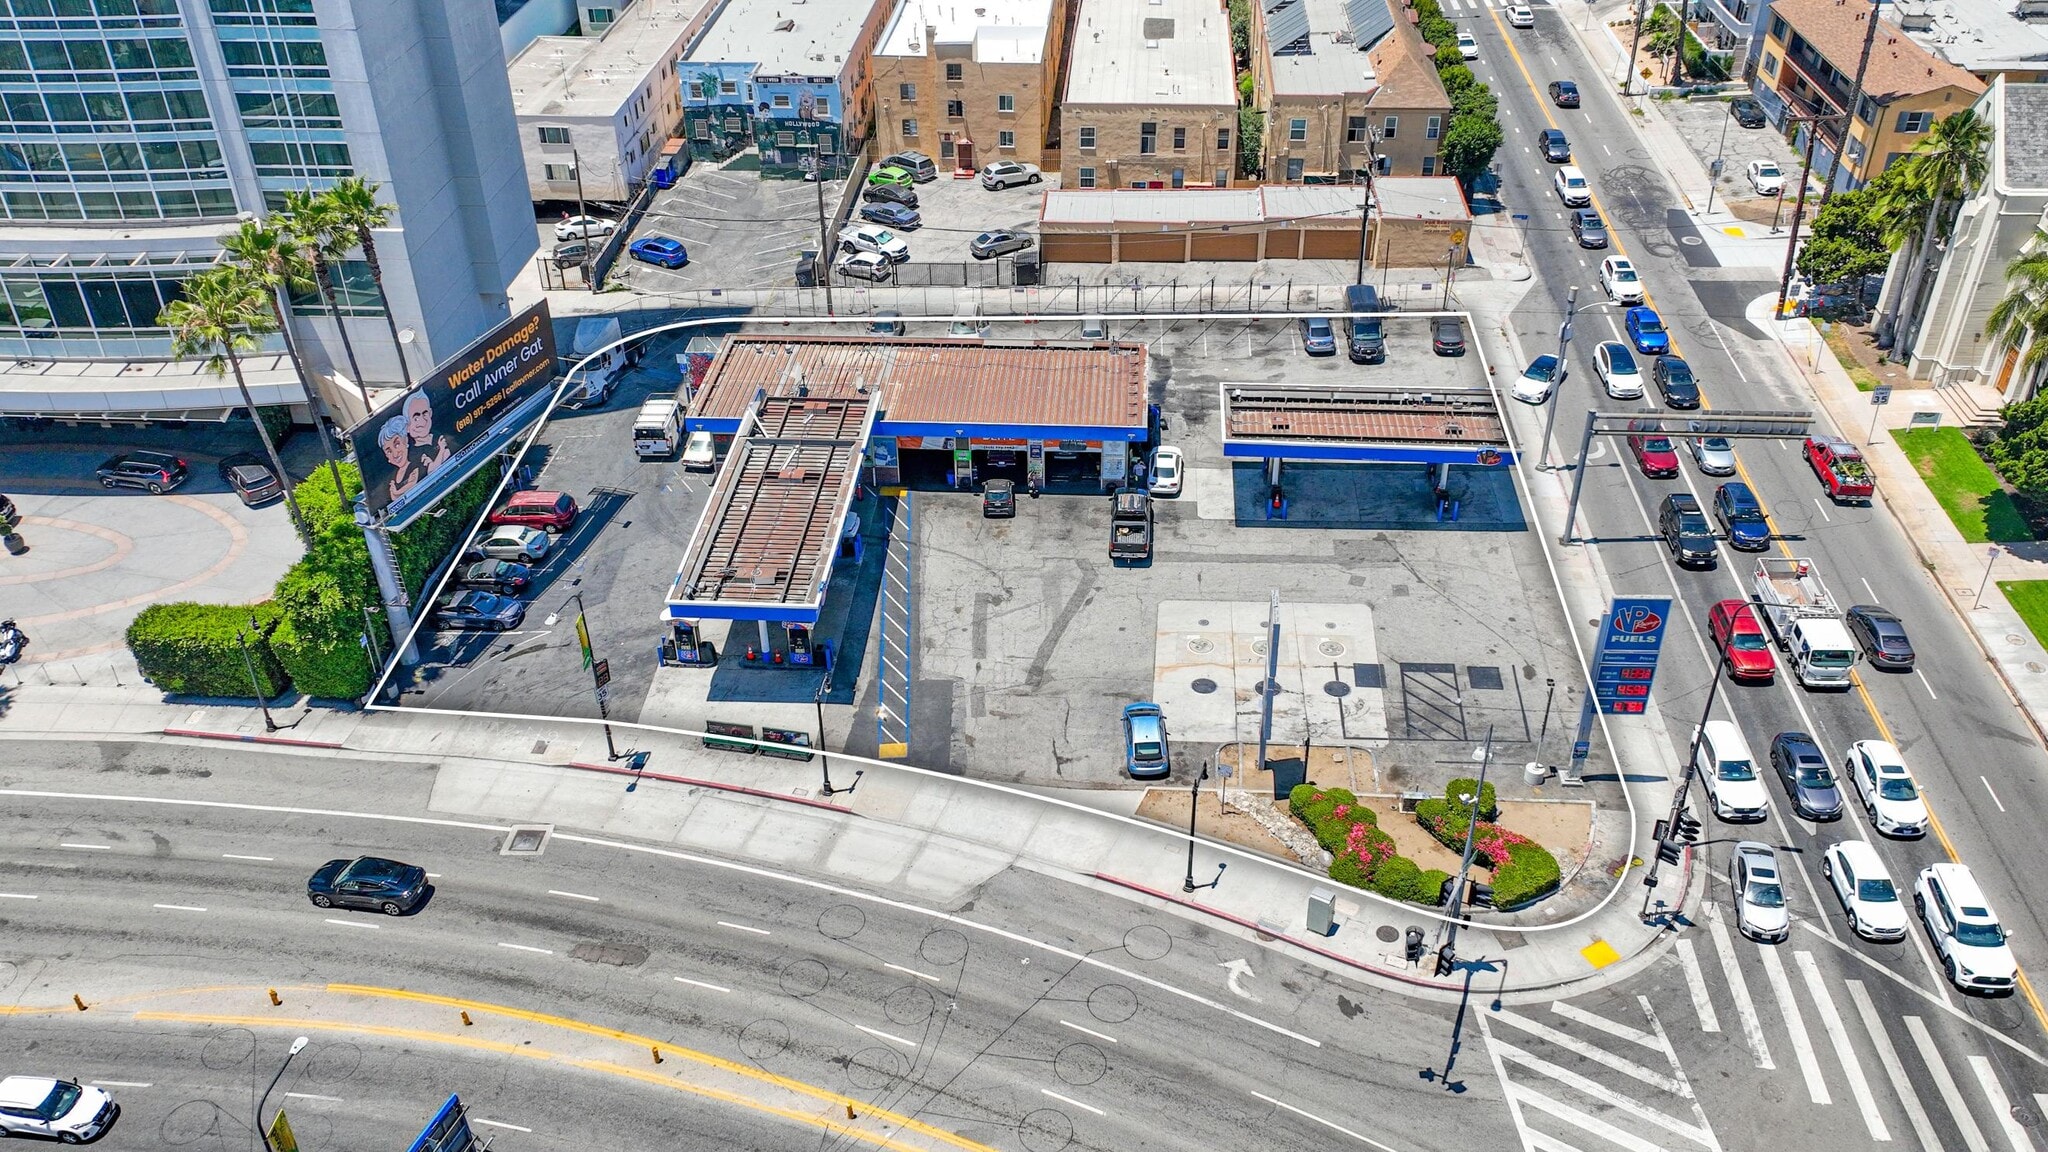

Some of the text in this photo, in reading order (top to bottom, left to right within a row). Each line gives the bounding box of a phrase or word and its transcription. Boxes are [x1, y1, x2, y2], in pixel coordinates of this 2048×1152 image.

[448, 315, 540, 389] Water Damage?
[455, 380, 481, 409] Call
[484, 356, 518, 391] Avner
[520, 337, 543, 362] Gat
[456, 412, 473, 432] (818)
[473, 392, 503, 418] 917-5256
[506, 358, 550, 395] callavner.com
[1611, 635, 1656, 643] FUELS
[1618, 605, 1650, 633] VP
